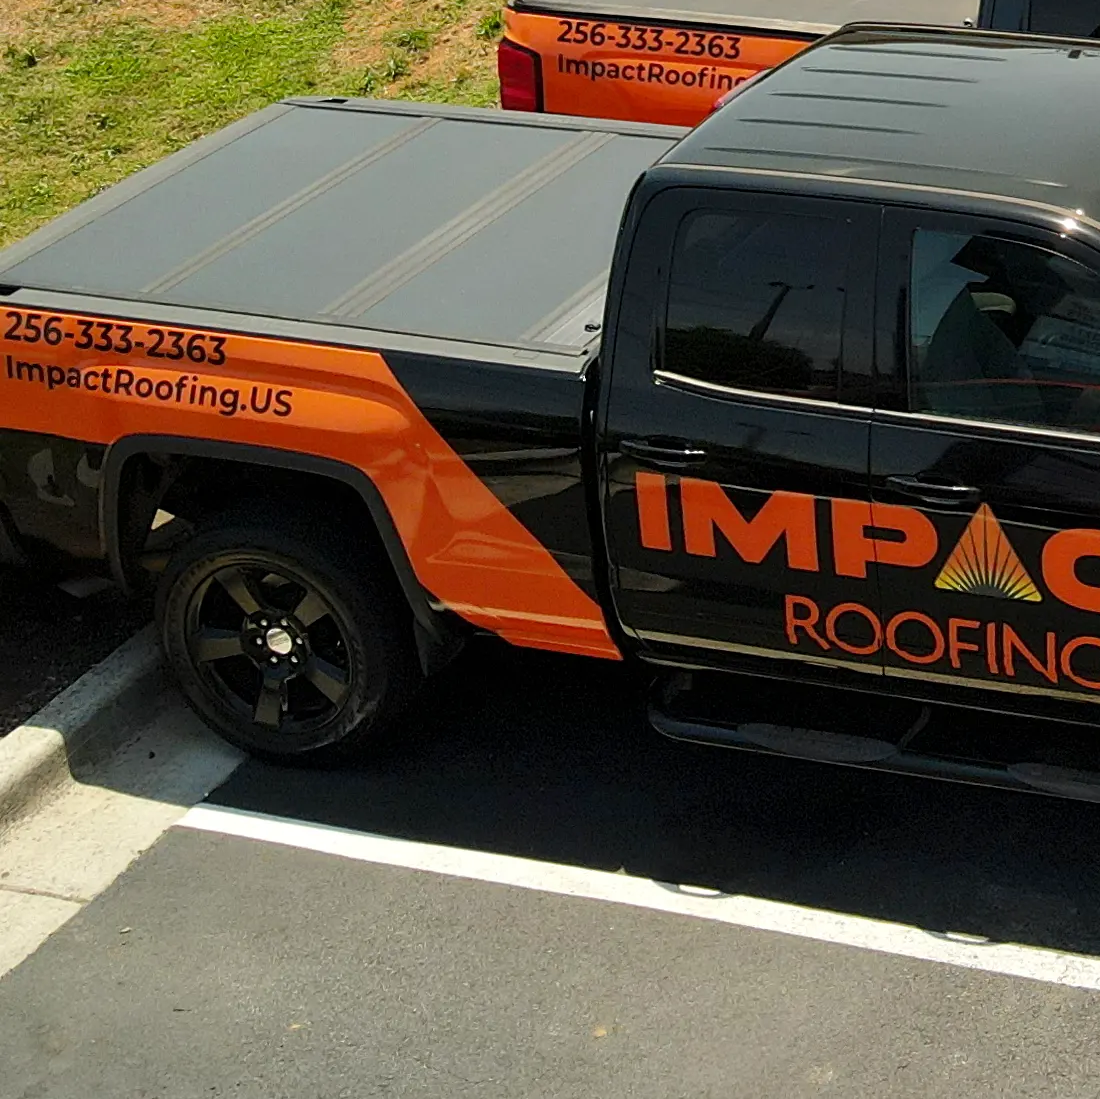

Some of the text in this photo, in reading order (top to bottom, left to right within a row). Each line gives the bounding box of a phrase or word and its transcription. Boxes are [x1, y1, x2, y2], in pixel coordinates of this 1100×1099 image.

[556, 20, 742, 60] 256-333-2363
[4, 311, 228, 366] 256-333-2363
[5, 355, 293, 417] ImpactRoofing.US
